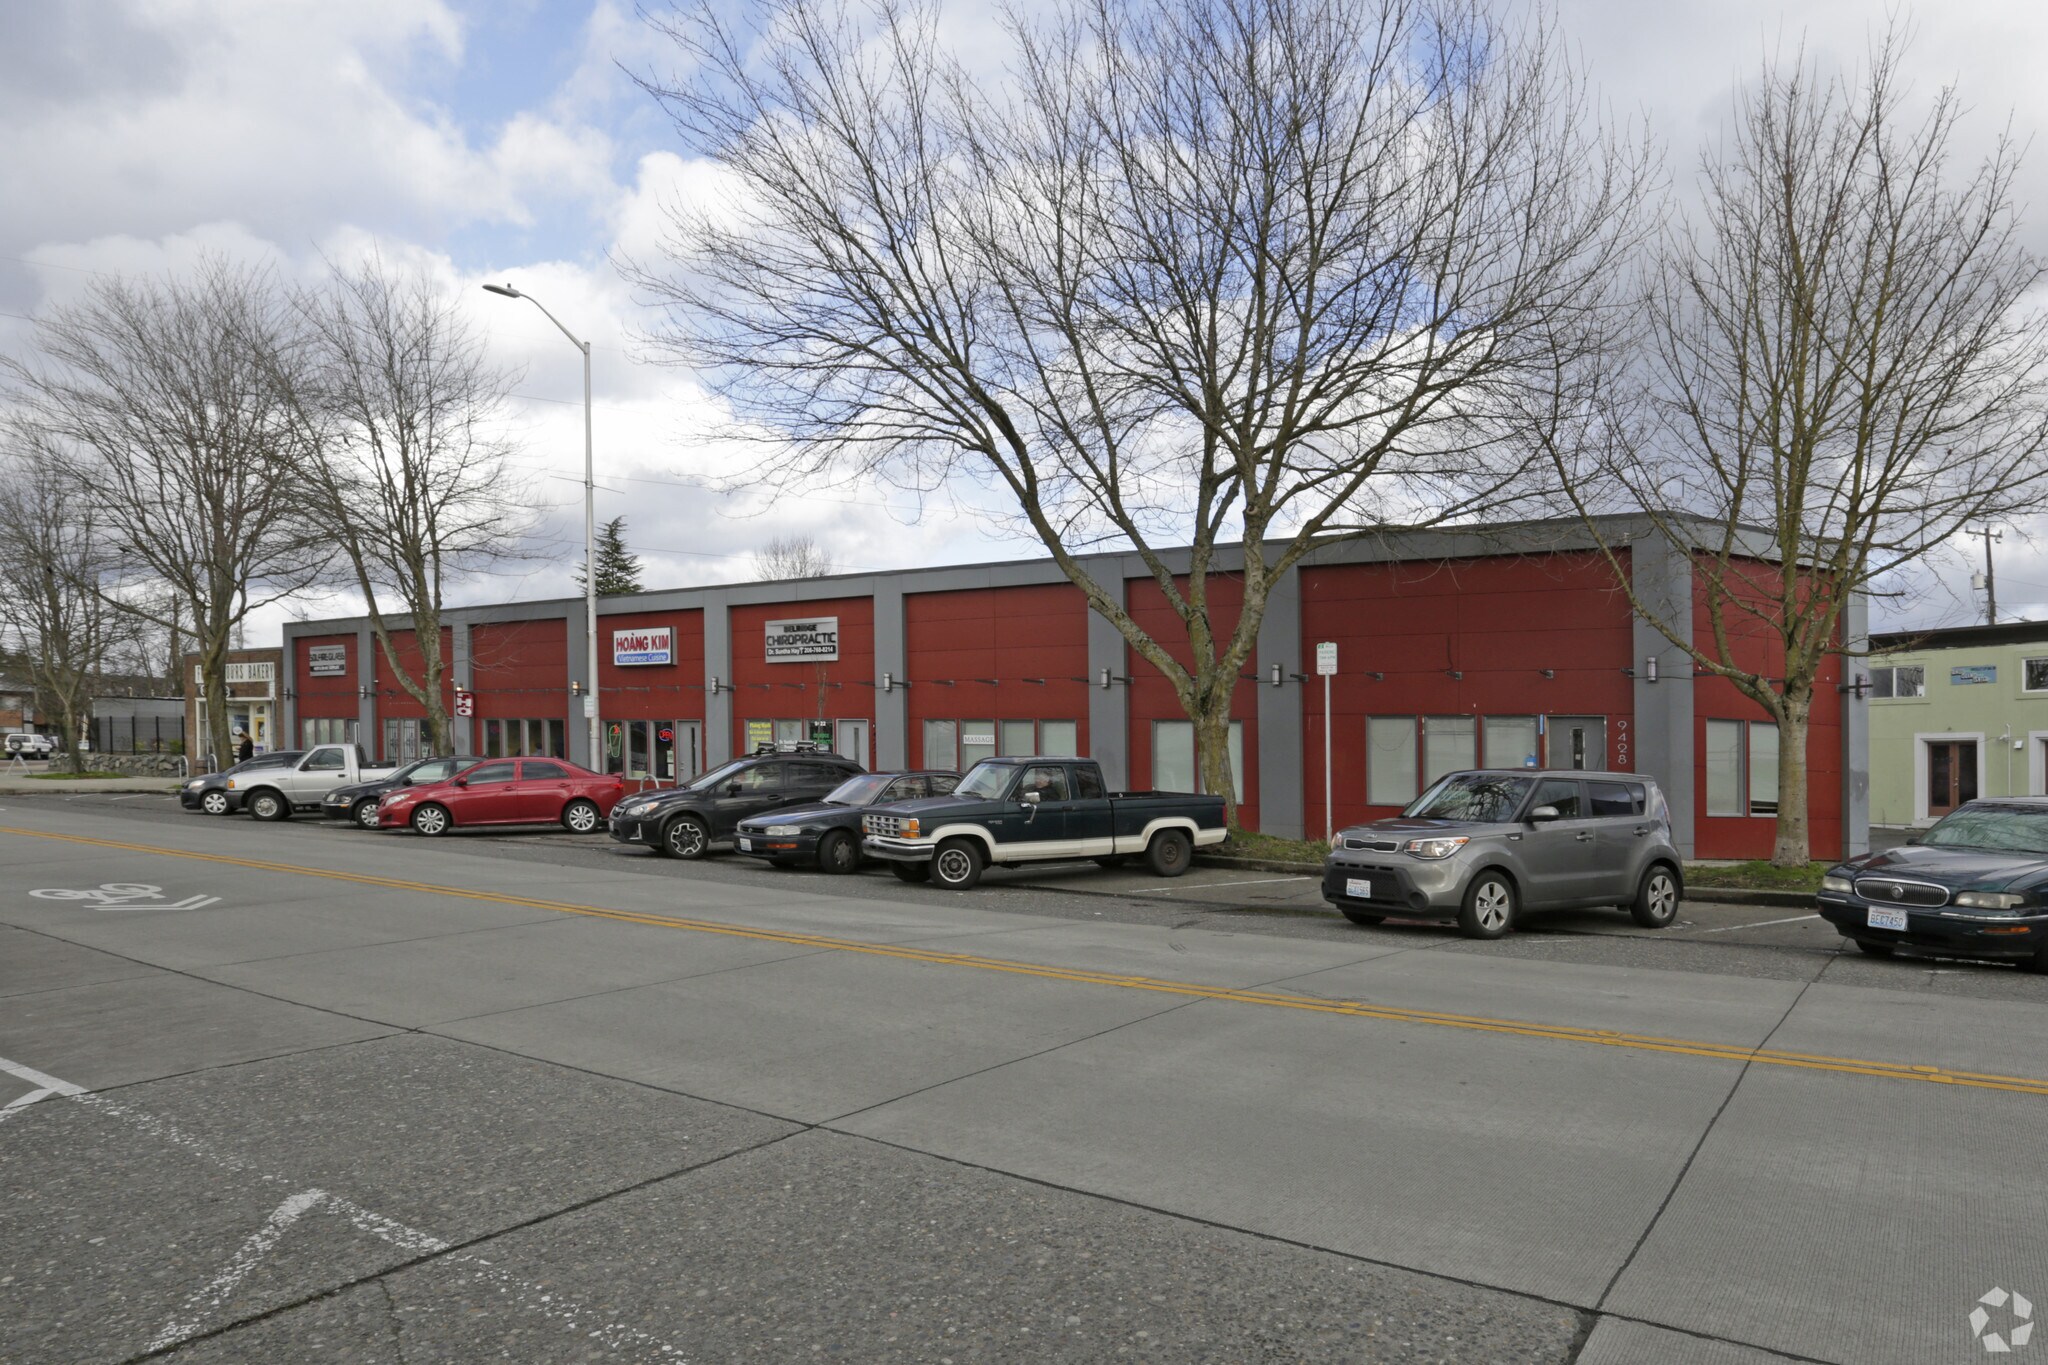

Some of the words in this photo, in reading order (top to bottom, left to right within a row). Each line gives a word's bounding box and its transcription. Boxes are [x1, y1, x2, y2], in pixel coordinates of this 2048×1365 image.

[651, 635, 669, 651] KIM
[766, 632, 836, 646] CHIROPRACTIC
[648, 653, 667, 662] Cuisine
[248, 664, 274, 679] BAKERY
[1617, 720, 1628, 765] 9428
